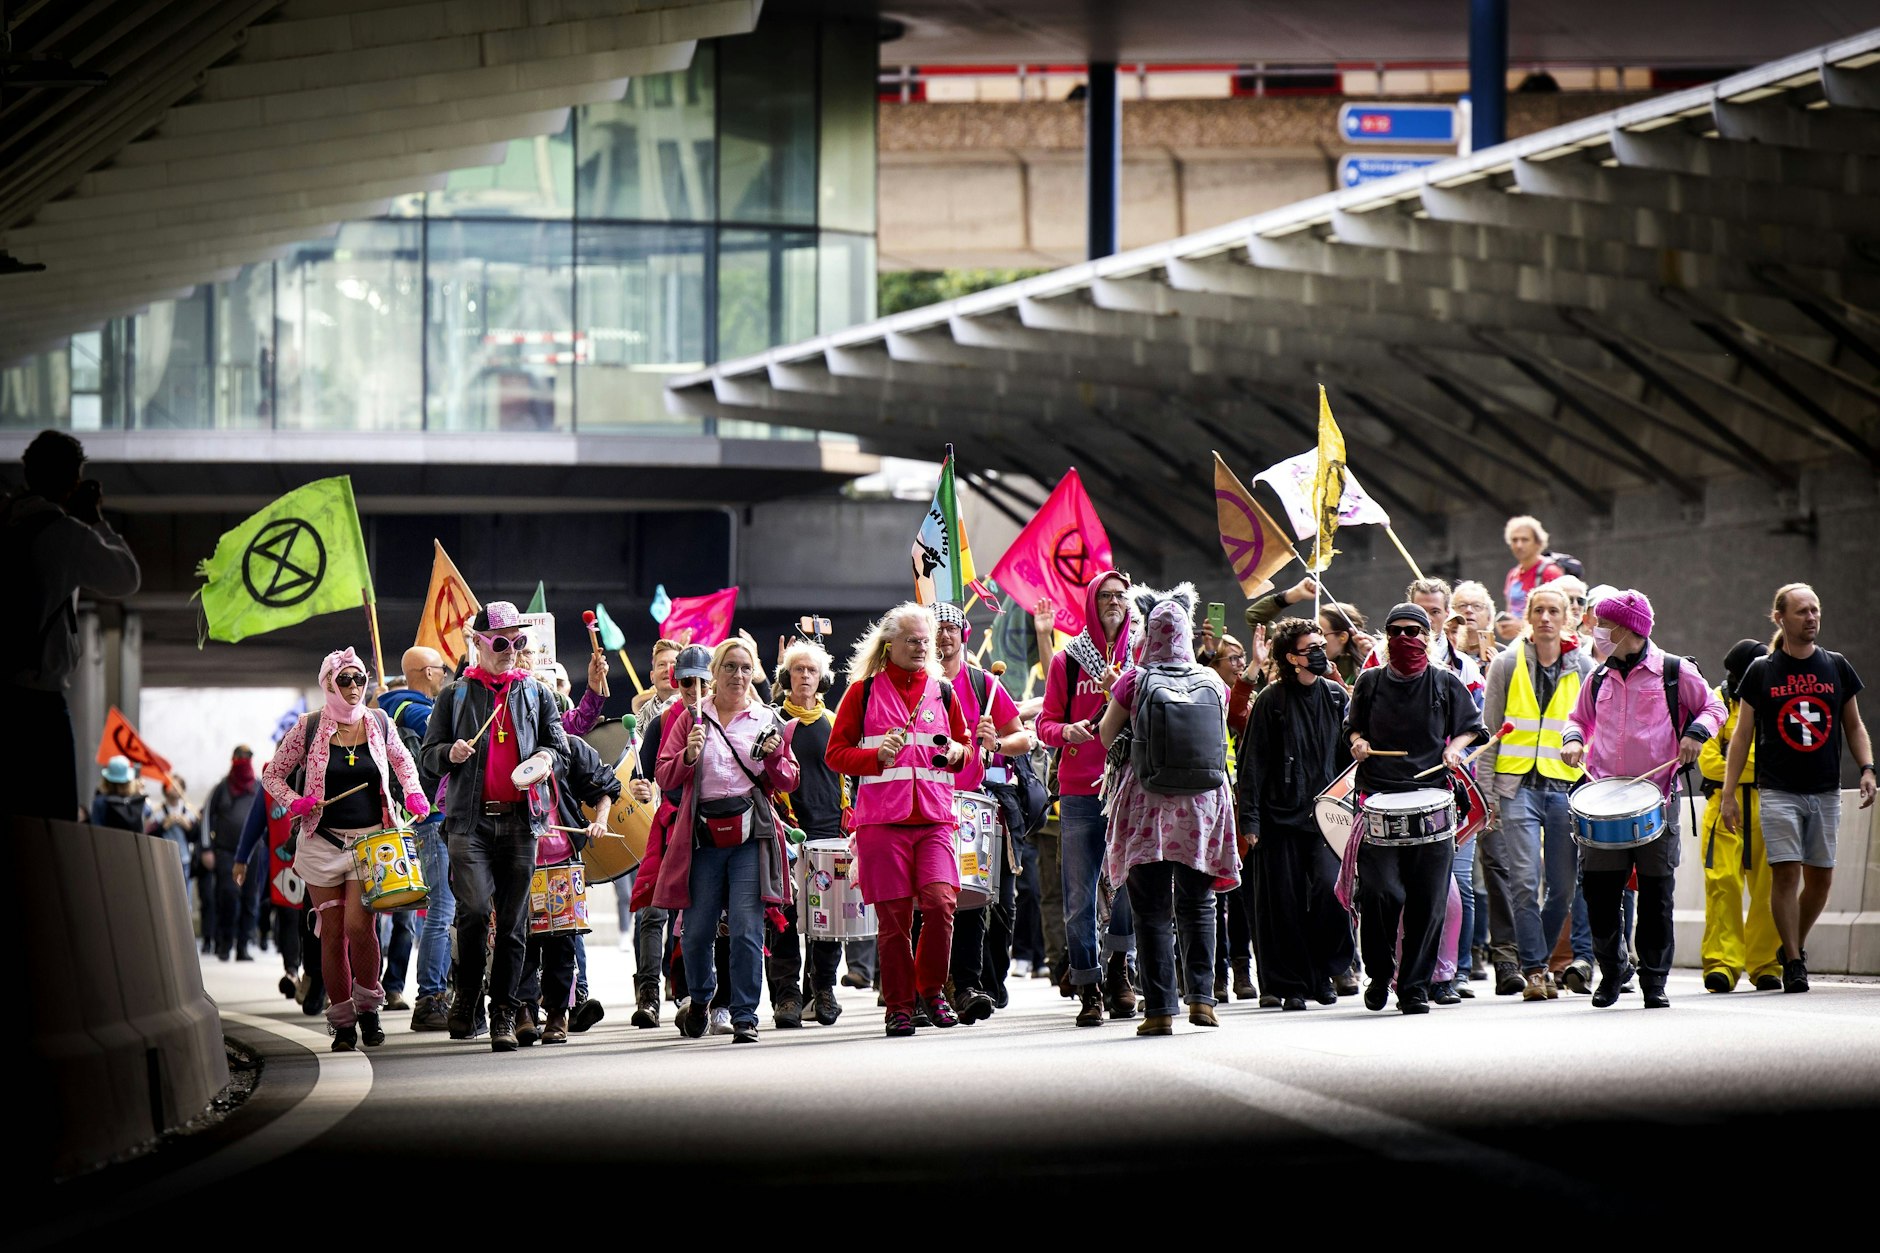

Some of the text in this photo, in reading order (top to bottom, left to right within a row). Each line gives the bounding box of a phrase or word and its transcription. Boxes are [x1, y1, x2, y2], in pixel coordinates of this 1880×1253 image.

[1787, 673, 1818, 685] BAD
[1770, 682, 1835, 698] RELIGION
[1325, 811, 1352, 827] GOPE
